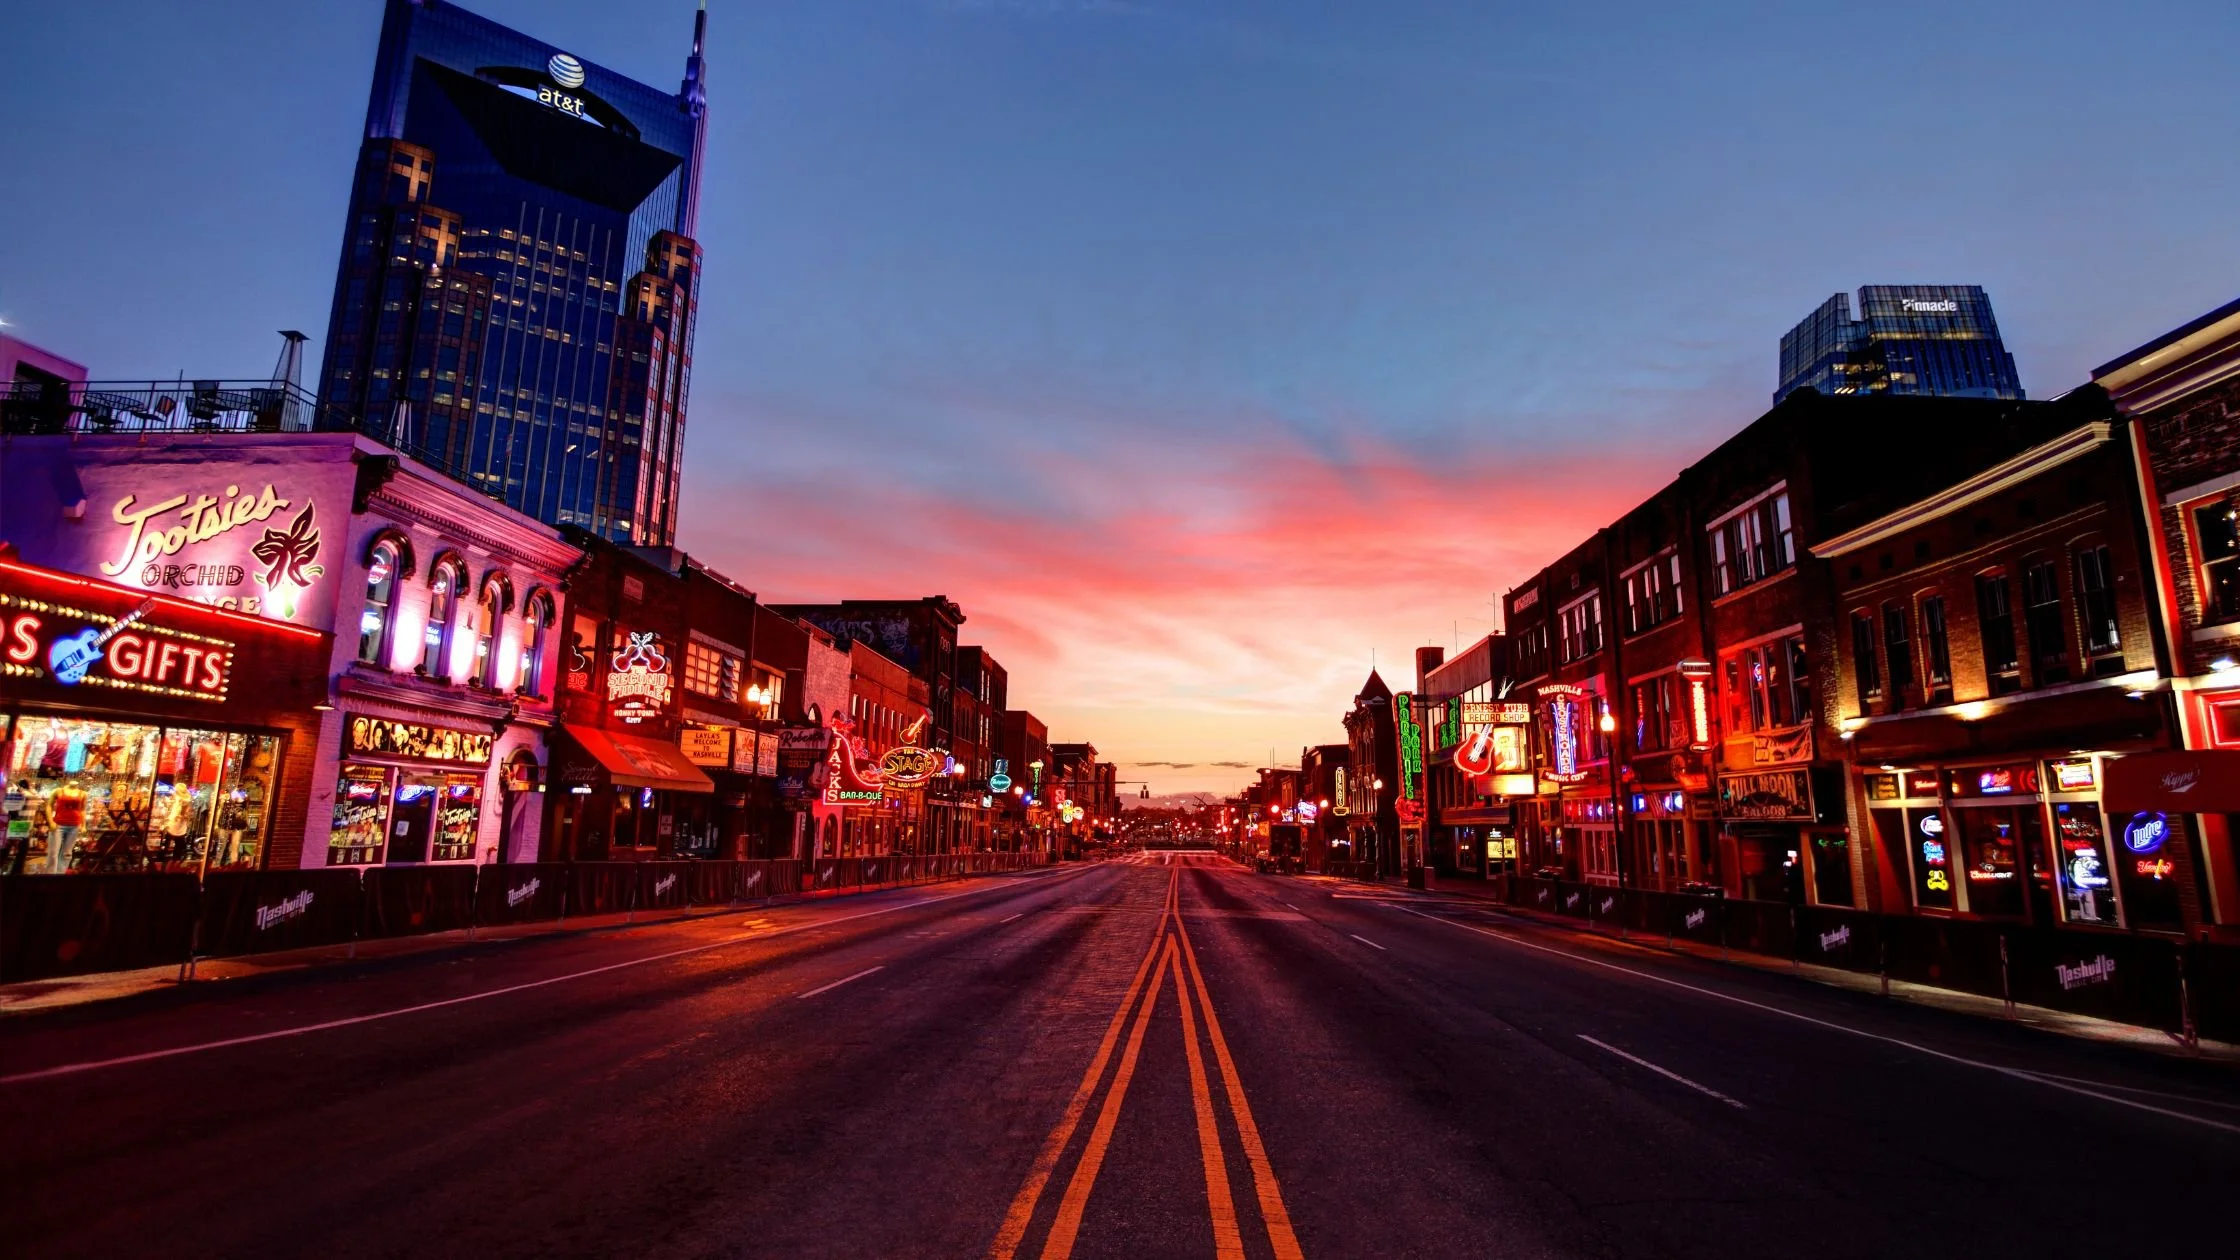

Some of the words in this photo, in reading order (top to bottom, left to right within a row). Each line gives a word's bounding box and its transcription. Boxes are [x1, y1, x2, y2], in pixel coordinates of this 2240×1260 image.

[538, 87, 584, 115] at&t
[1902, 299, 1957, 311] Pinnacle
[100, 484, 290, 576] Tootsies
[141, 563, 244, 589] ORCHID
[0, 615, 42, 661] S
[109, 634, 222, 688] GIFTS
[607, 672, 668, 688] SECOND
[608, 684, 665, 702] FIDDLE
[1537, 684, 1583, 696] NASHVILLE
[1463, 703, 1500, 713] ERNEST
[1503, 703, 1529, 713] TUBB
[1469, 713, 1500, 722] RECORD
[1503, 713, 1525, 722] SHOP
[1398, 694, 1414, 799] PARADISE
[1556, 693, 1570, 773] CROSSROADS
[1410, 723, 1422, 773] PARK
[883, 751, 934, 775] STAGE
[1729, 776, 1757, 808] FULL
[1758, 773, 1797, 806] MOON
[1742, 804, 1786, 817] SALOON
[256, 889, 315, 930] Nashville
[2054, 954, 2116, 990] Nashville
